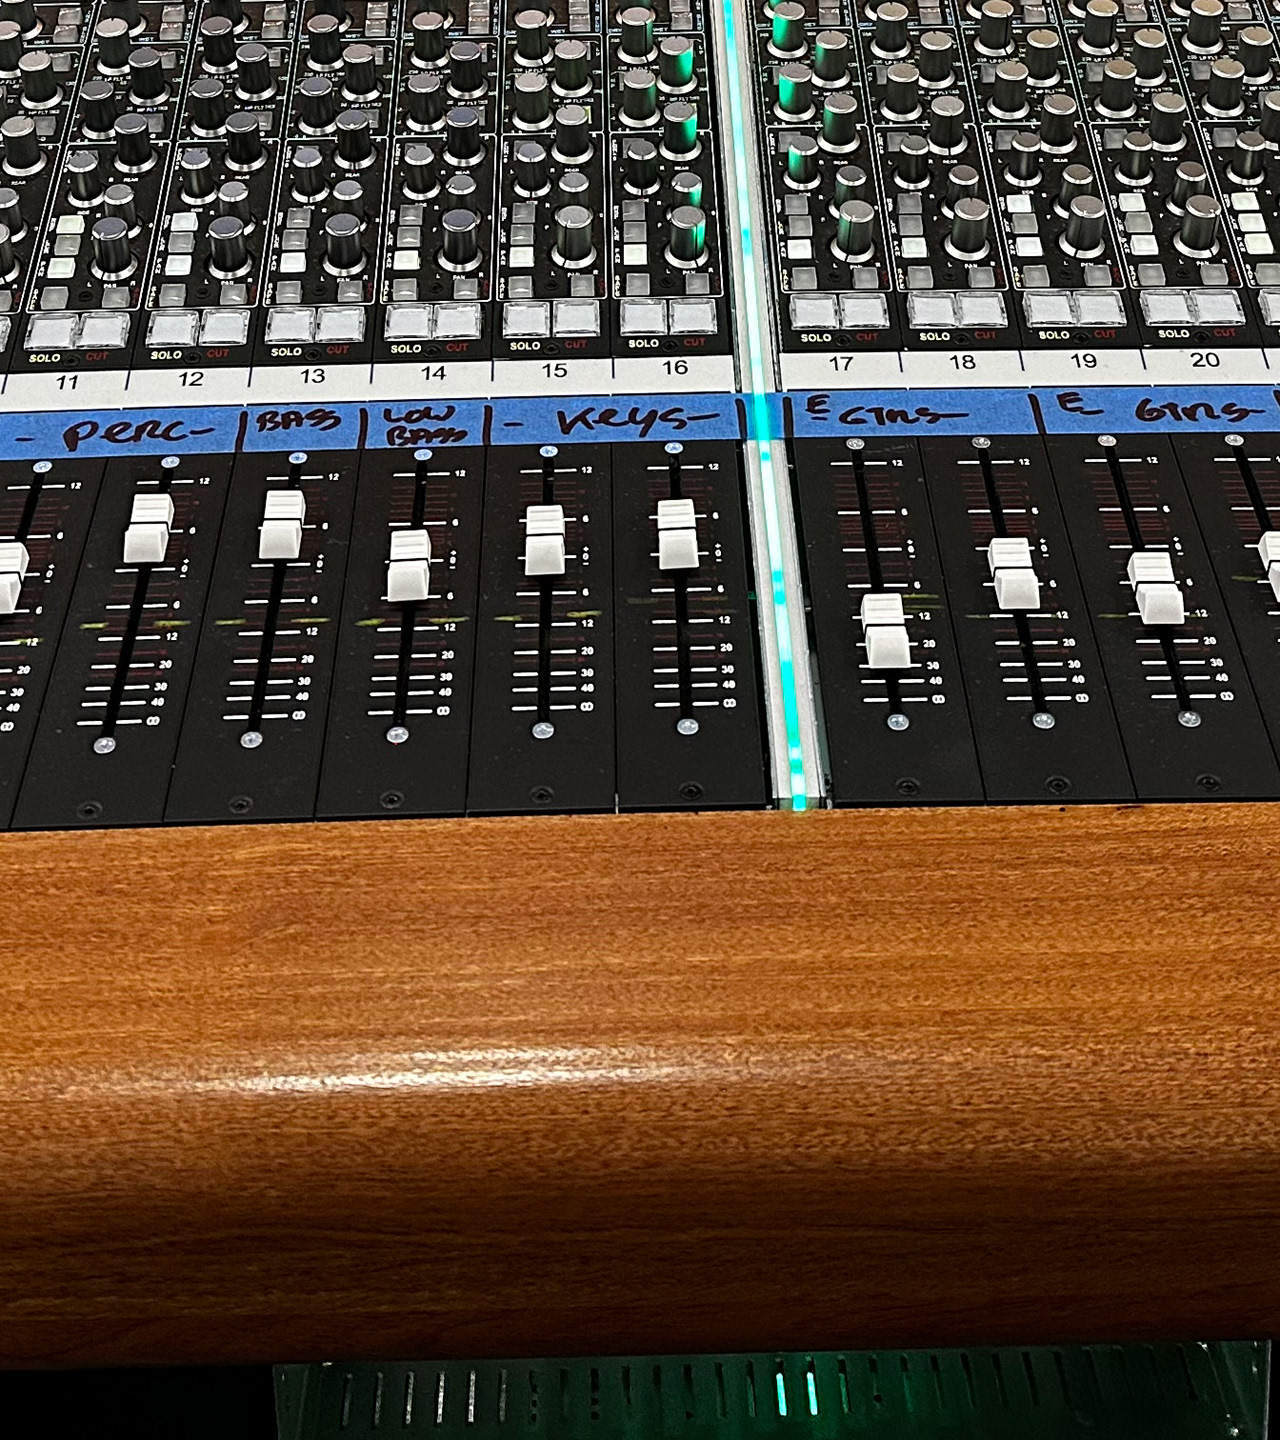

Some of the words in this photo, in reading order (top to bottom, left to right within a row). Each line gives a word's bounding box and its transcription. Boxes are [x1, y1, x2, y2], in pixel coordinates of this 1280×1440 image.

[272, 347, 303, 358] SOLO
[1190, 352, 1220, 368] 20
[662, 359, 689, 375] 16
[829, 356, 854, 371] 17
[949, 354, 976, 370] 18
[1070, 353, 1097, 369] 19
[300, 368, 326, 384] 13
[421, 365, 447, 381] 14
[542, 363, 568, 378] 15
[56, 374, 78, 390] 11
[178, 371, 204, 387] 12
[257, 409, 341, 432] BASS
[383, 405, 456, 424] LOW
